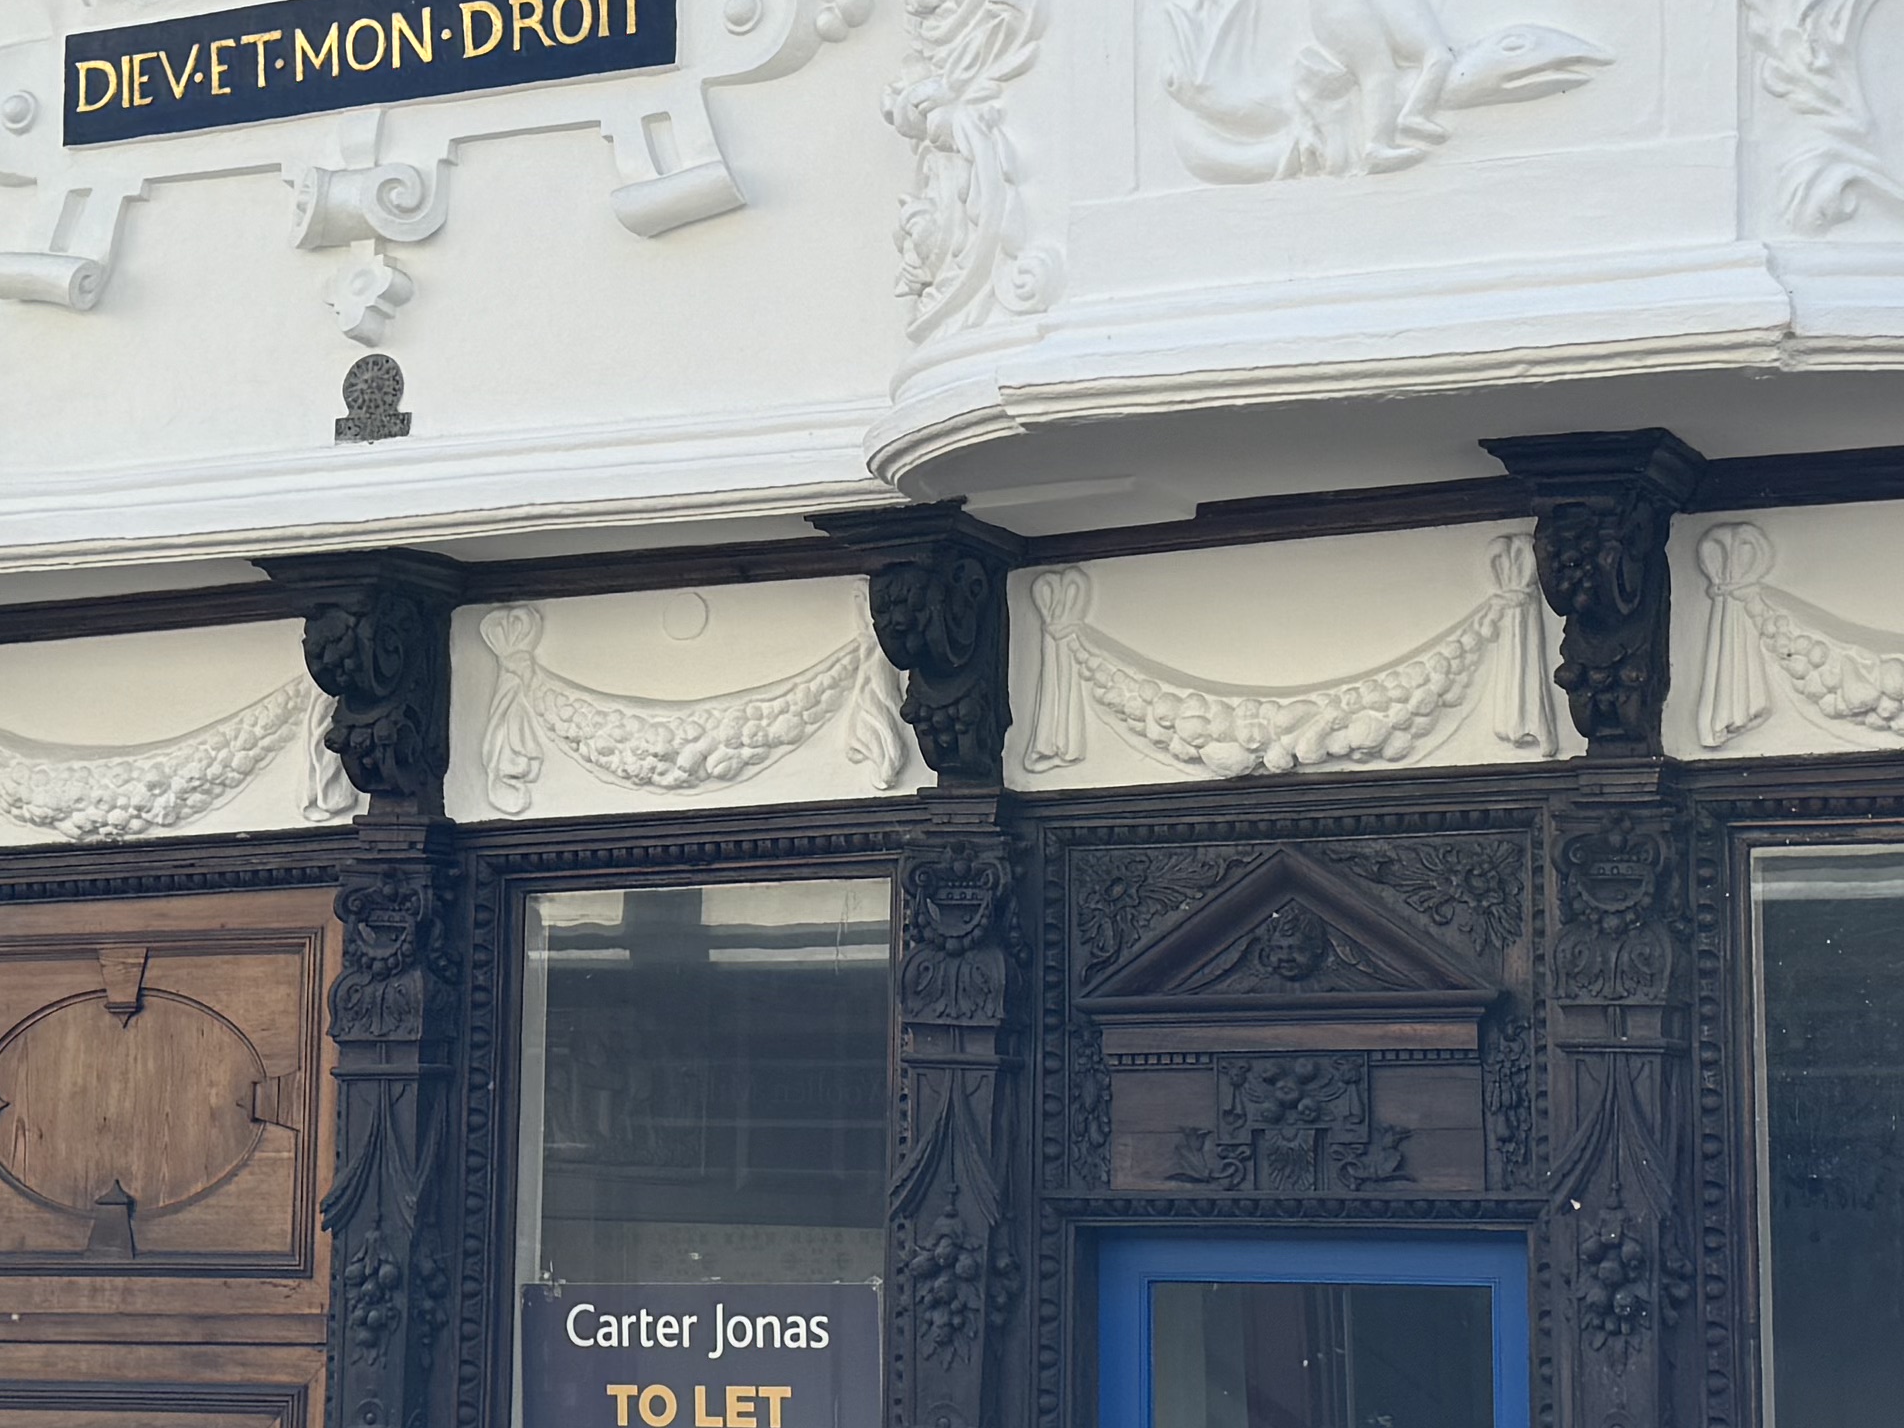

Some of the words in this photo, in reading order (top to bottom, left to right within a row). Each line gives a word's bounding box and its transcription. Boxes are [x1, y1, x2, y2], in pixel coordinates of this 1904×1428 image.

[565, 1303, 697, 1348] Carter
[708, 1303, 830, 1359] Jonas
[606, 1384, 678, 1428] TO
[694, 1385, 792, 1428] LET
